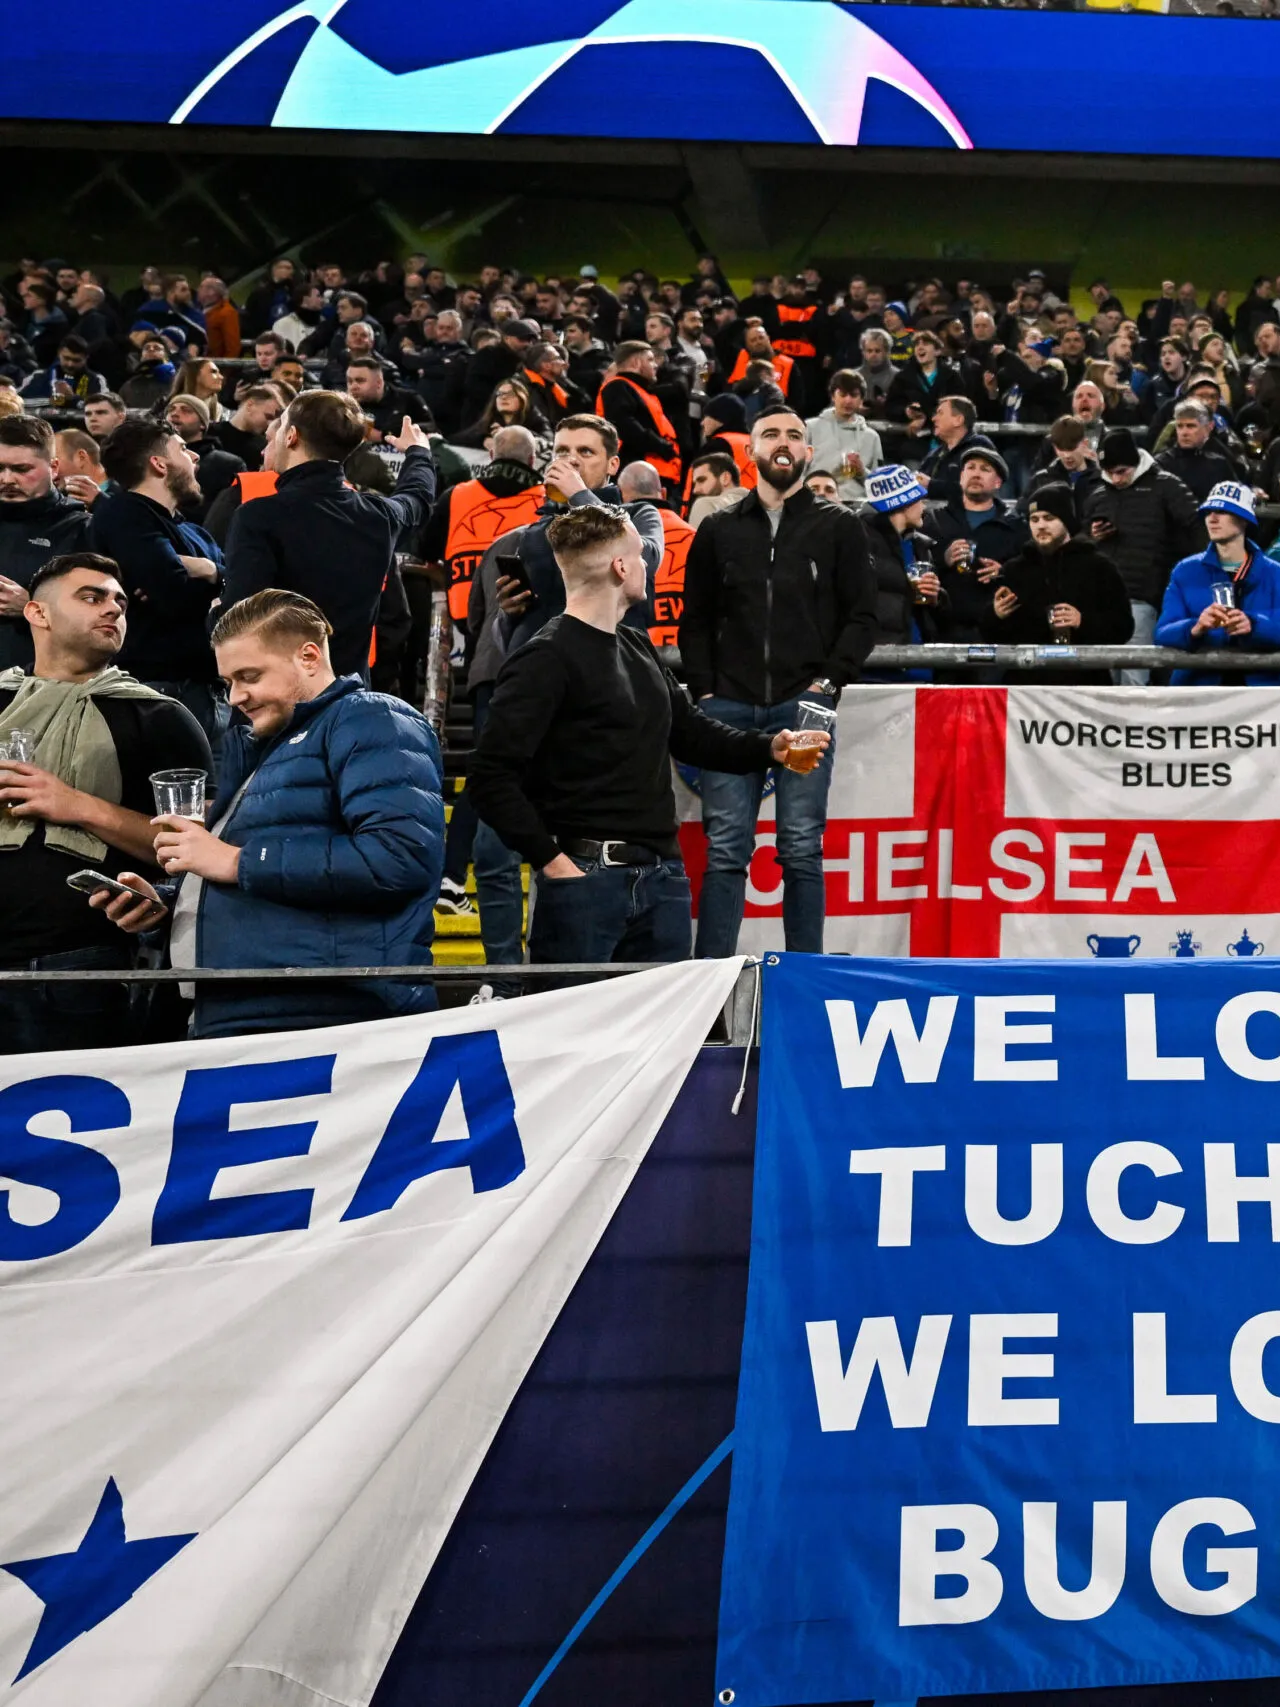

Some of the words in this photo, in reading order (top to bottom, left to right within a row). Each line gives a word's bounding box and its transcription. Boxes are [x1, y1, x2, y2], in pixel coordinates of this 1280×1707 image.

[1122, 763, 1232, 788] BLUES
[825, 994, 1059, 1089] WE
[805, 1313, 1060, 1432] WE
